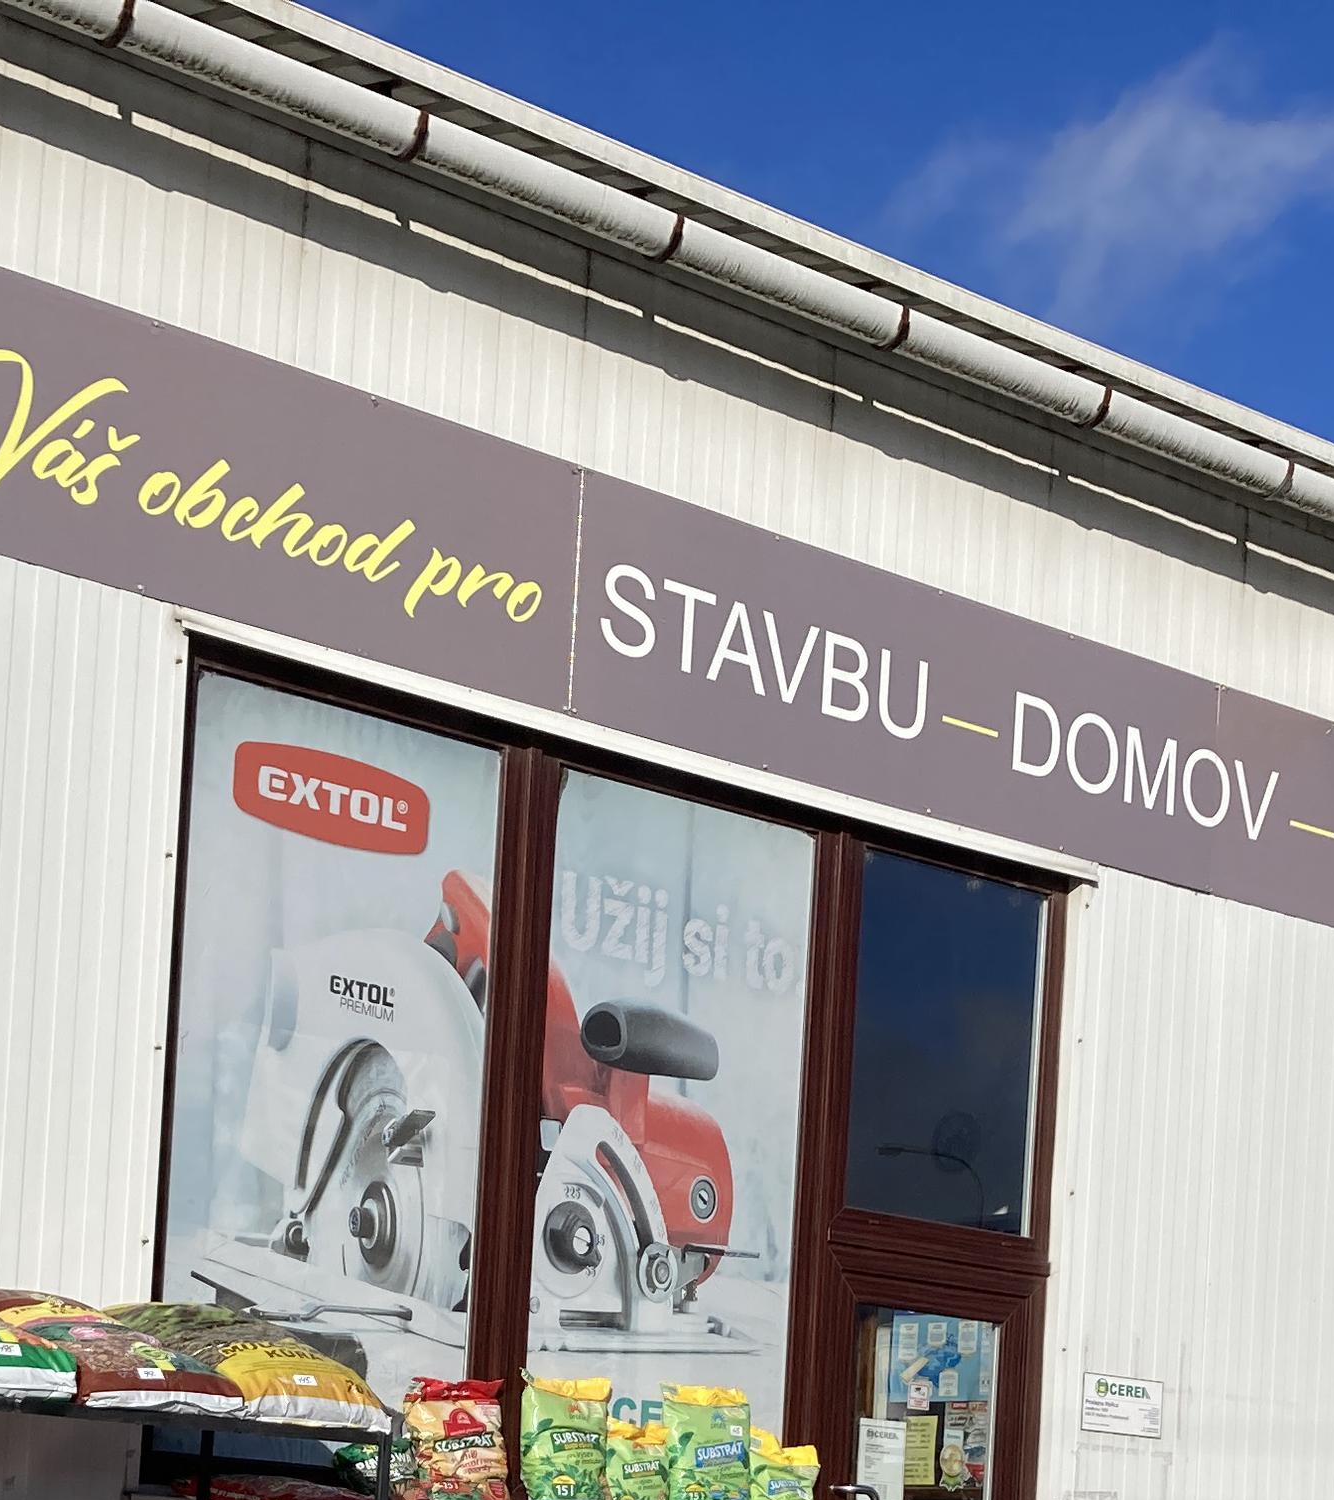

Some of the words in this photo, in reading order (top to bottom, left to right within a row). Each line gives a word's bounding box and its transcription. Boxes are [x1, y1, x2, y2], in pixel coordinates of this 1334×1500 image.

[137, 458, 401, 584] obchod
[403, 546, 545, 624] pro
[599, 563, 930, 740] STAVBU
[1011, 690, 1280, 842] DOMOV
[561, 870, 668, 987] Užij
[682, 903, 730, 980] si
[339, 996, 395, 1023] PREMIUM
[697, 1441, 743, 1461] SUBSTRÁT
[555, 1485, 568, 1496] 15
